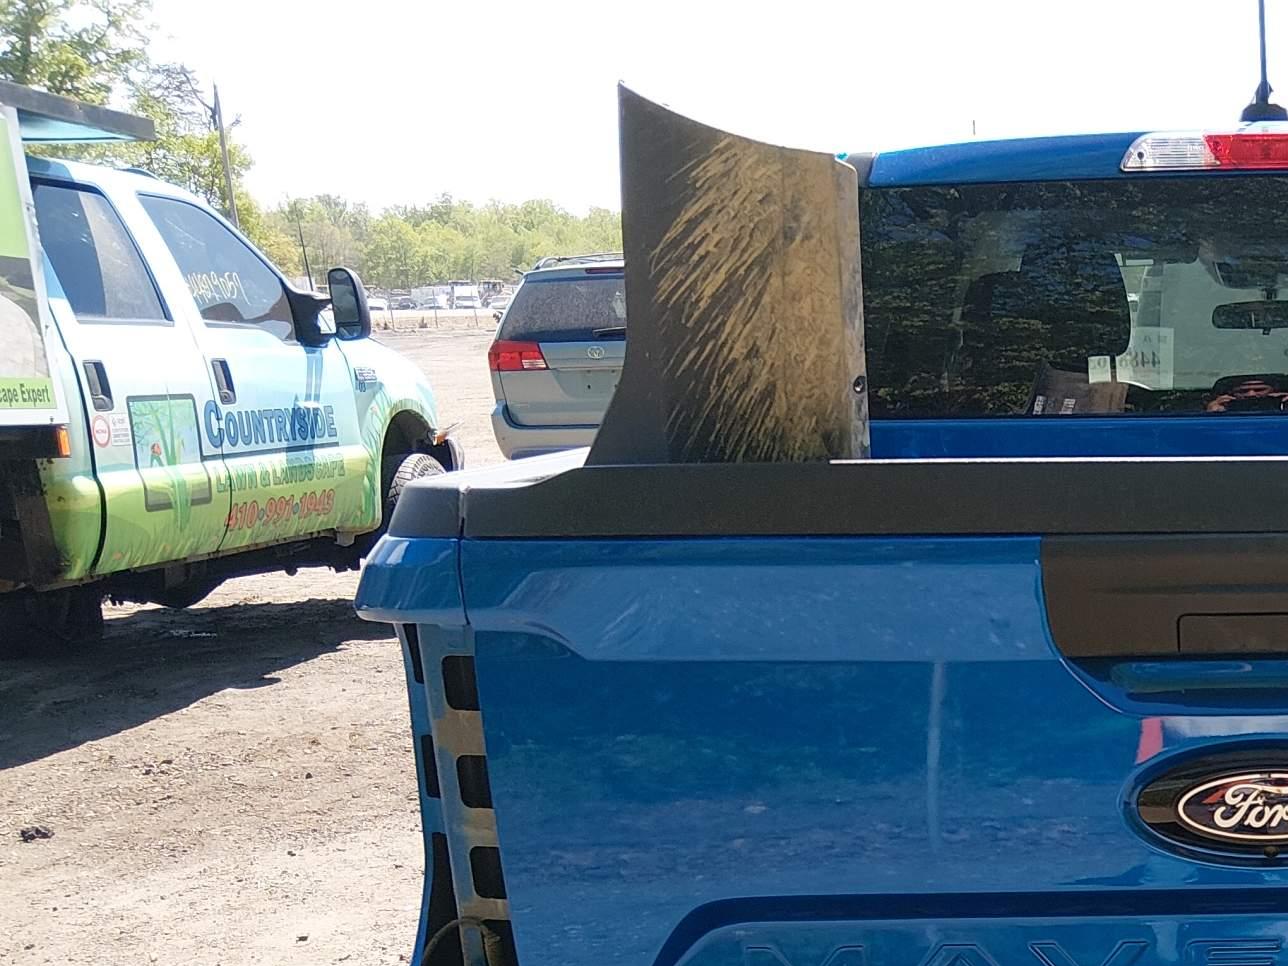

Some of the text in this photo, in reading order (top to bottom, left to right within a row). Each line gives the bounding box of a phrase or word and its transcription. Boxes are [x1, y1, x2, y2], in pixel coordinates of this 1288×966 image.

[19, 383, 50, 407] Expert
[203, 399, 338, 449] COUNTRYSIDE
[214, 463, 258, 493] LAWN
[259, 461, 271, 488] &
